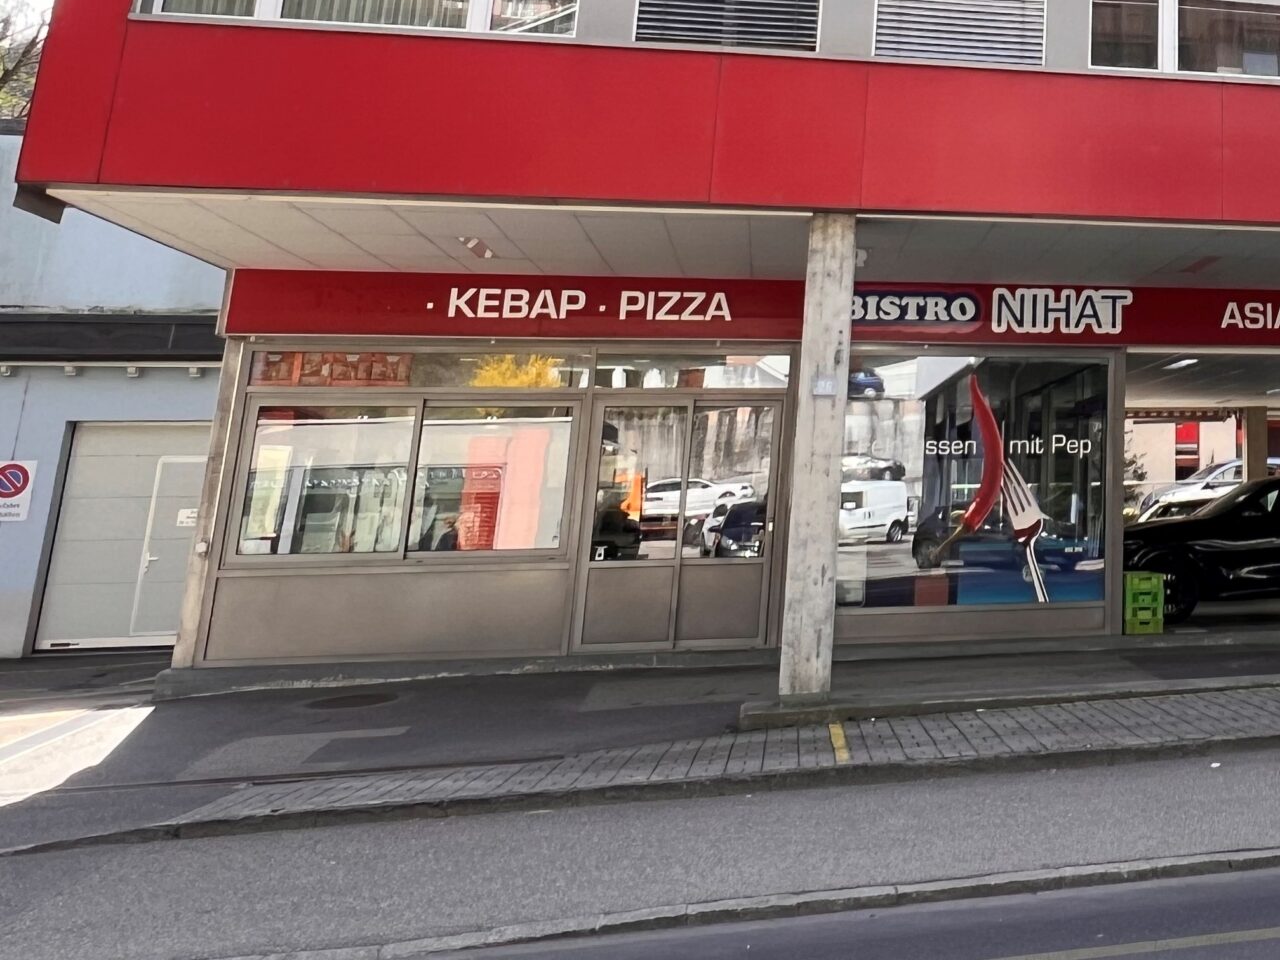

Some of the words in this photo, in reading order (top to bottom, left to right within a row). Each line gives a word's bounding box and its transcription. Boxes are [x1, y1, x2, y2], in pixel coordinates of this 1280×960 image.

[448, 288, 587, 319] KEBAP
[619, 290, 732, 321] PIZZA
[850, 295, 976, 322] BISTRO
[992, 288, 1132, 333] NIHAT
[1009, 435, 1044, 455] mit
[1051, 434, 1092, 459] Pep
